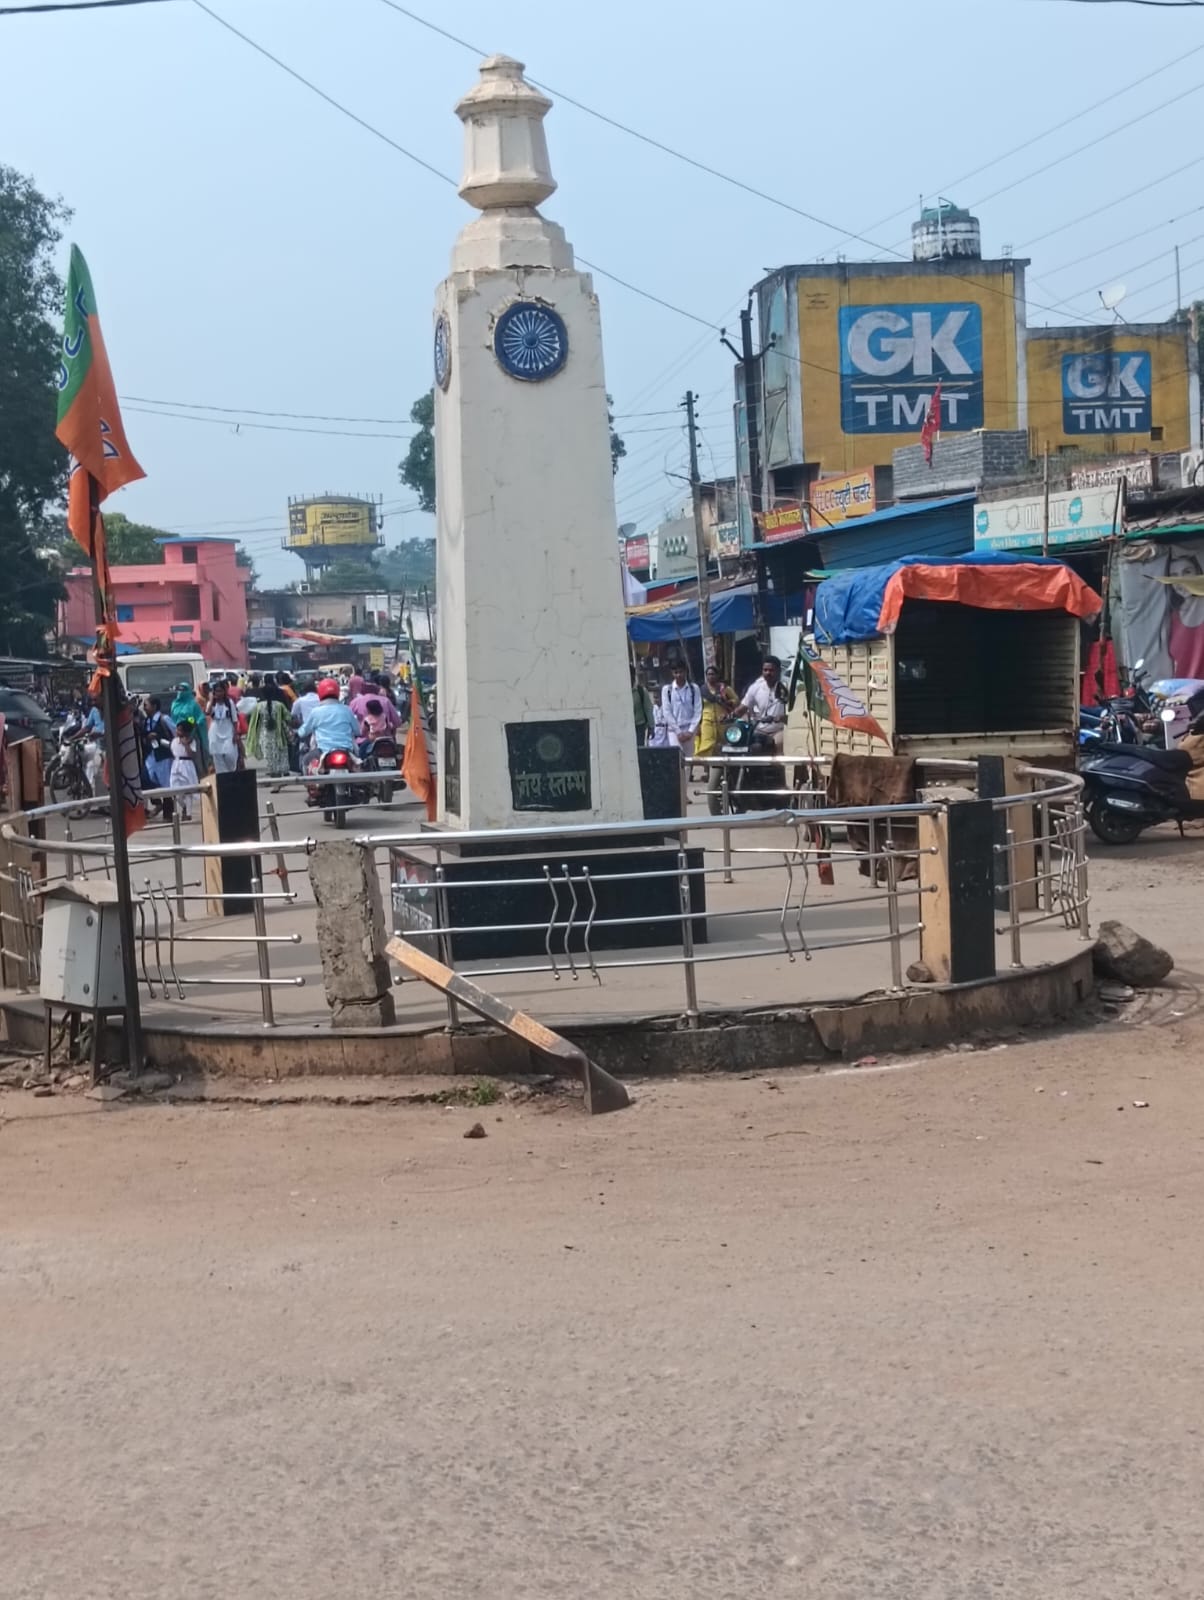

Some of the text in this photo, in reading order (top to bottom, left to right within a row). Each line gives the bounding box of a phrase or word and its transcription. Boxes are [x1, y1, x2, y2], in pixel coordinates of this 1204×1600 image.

[847, 310, 974, 376] GK
[1067, 357, 1146, 399] GK
[855, 393, 969, 426] TMT
[1071, 408, 1143, 430] TMT
